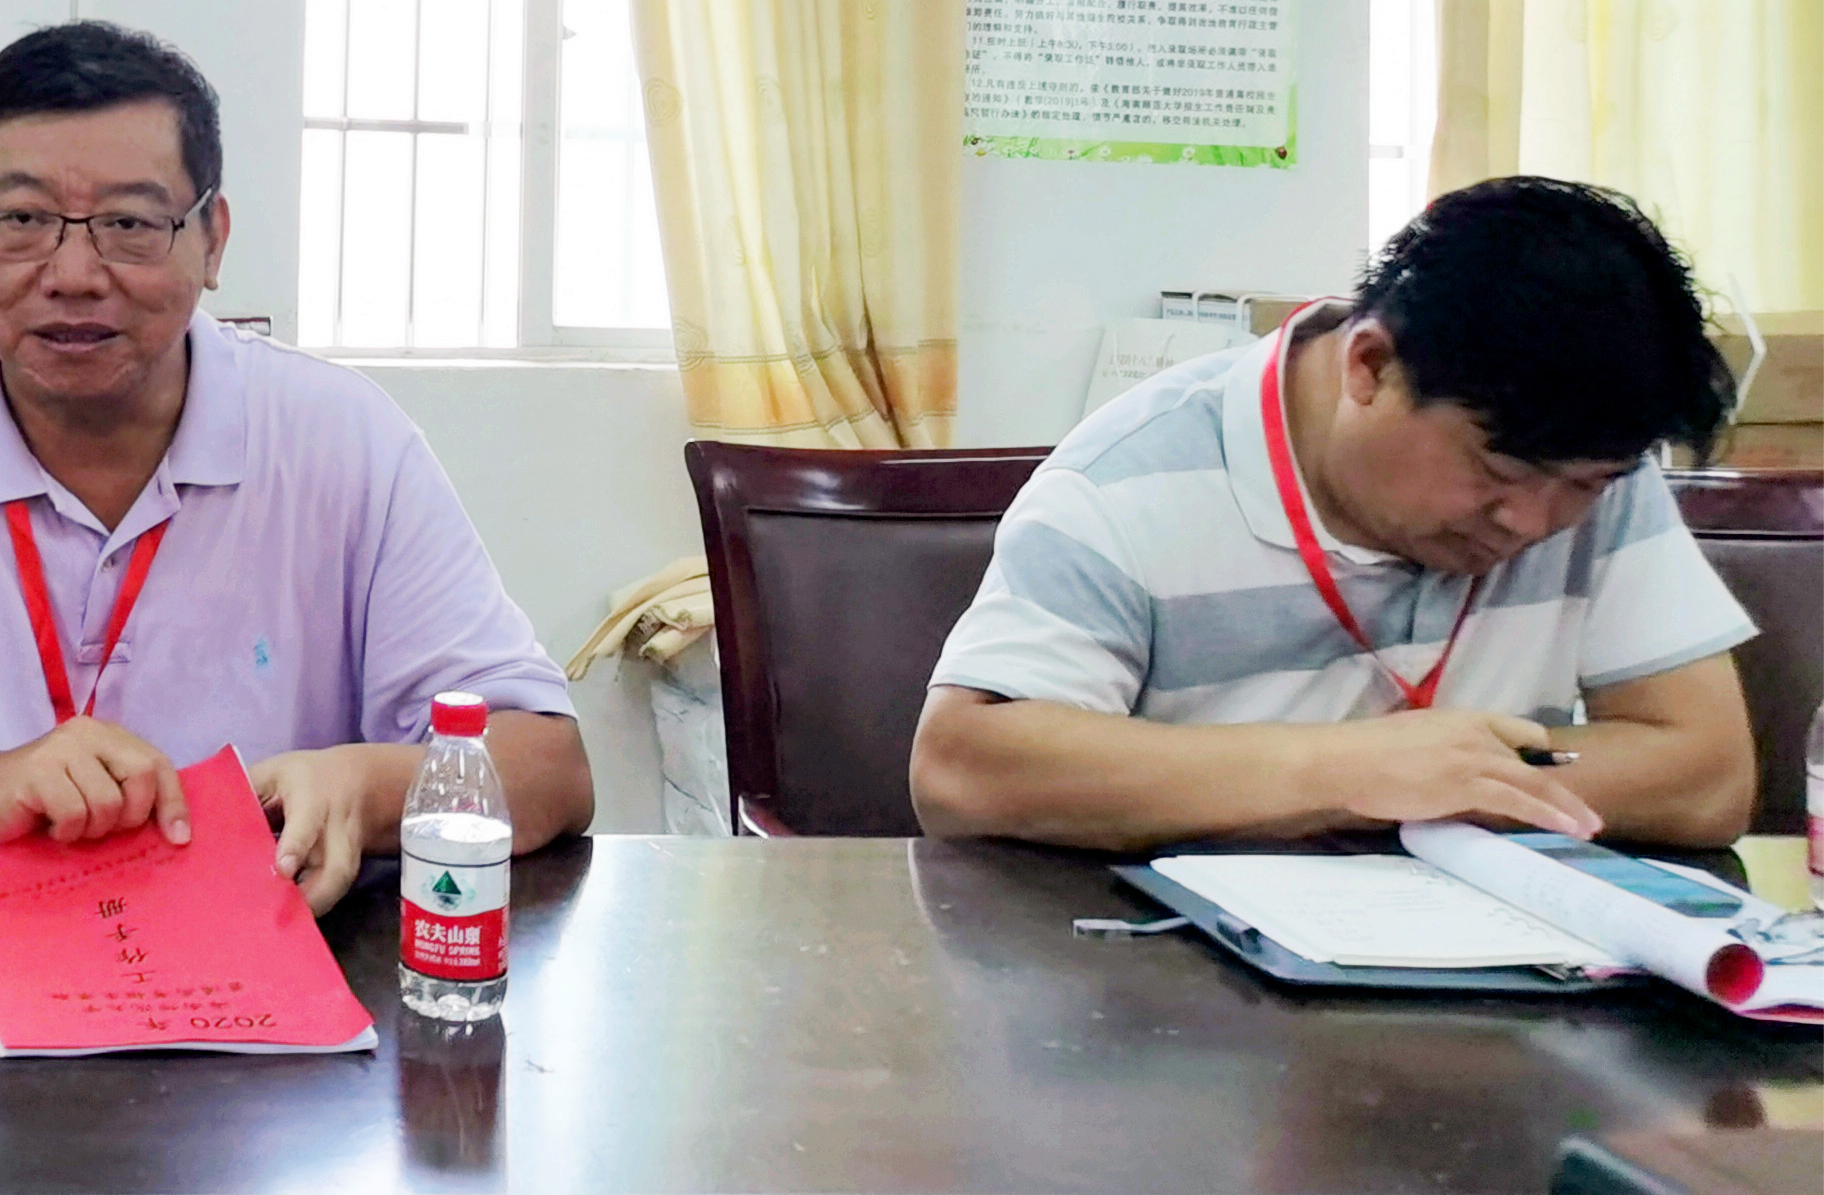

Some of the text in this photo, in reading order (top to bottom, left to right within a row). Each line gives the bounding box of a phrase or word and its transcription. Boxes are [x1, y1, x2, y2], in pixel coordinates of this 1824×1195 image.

[415, 919, 481, 945] 农夫山泉
[190, 1014, 277, 1029] 2020
